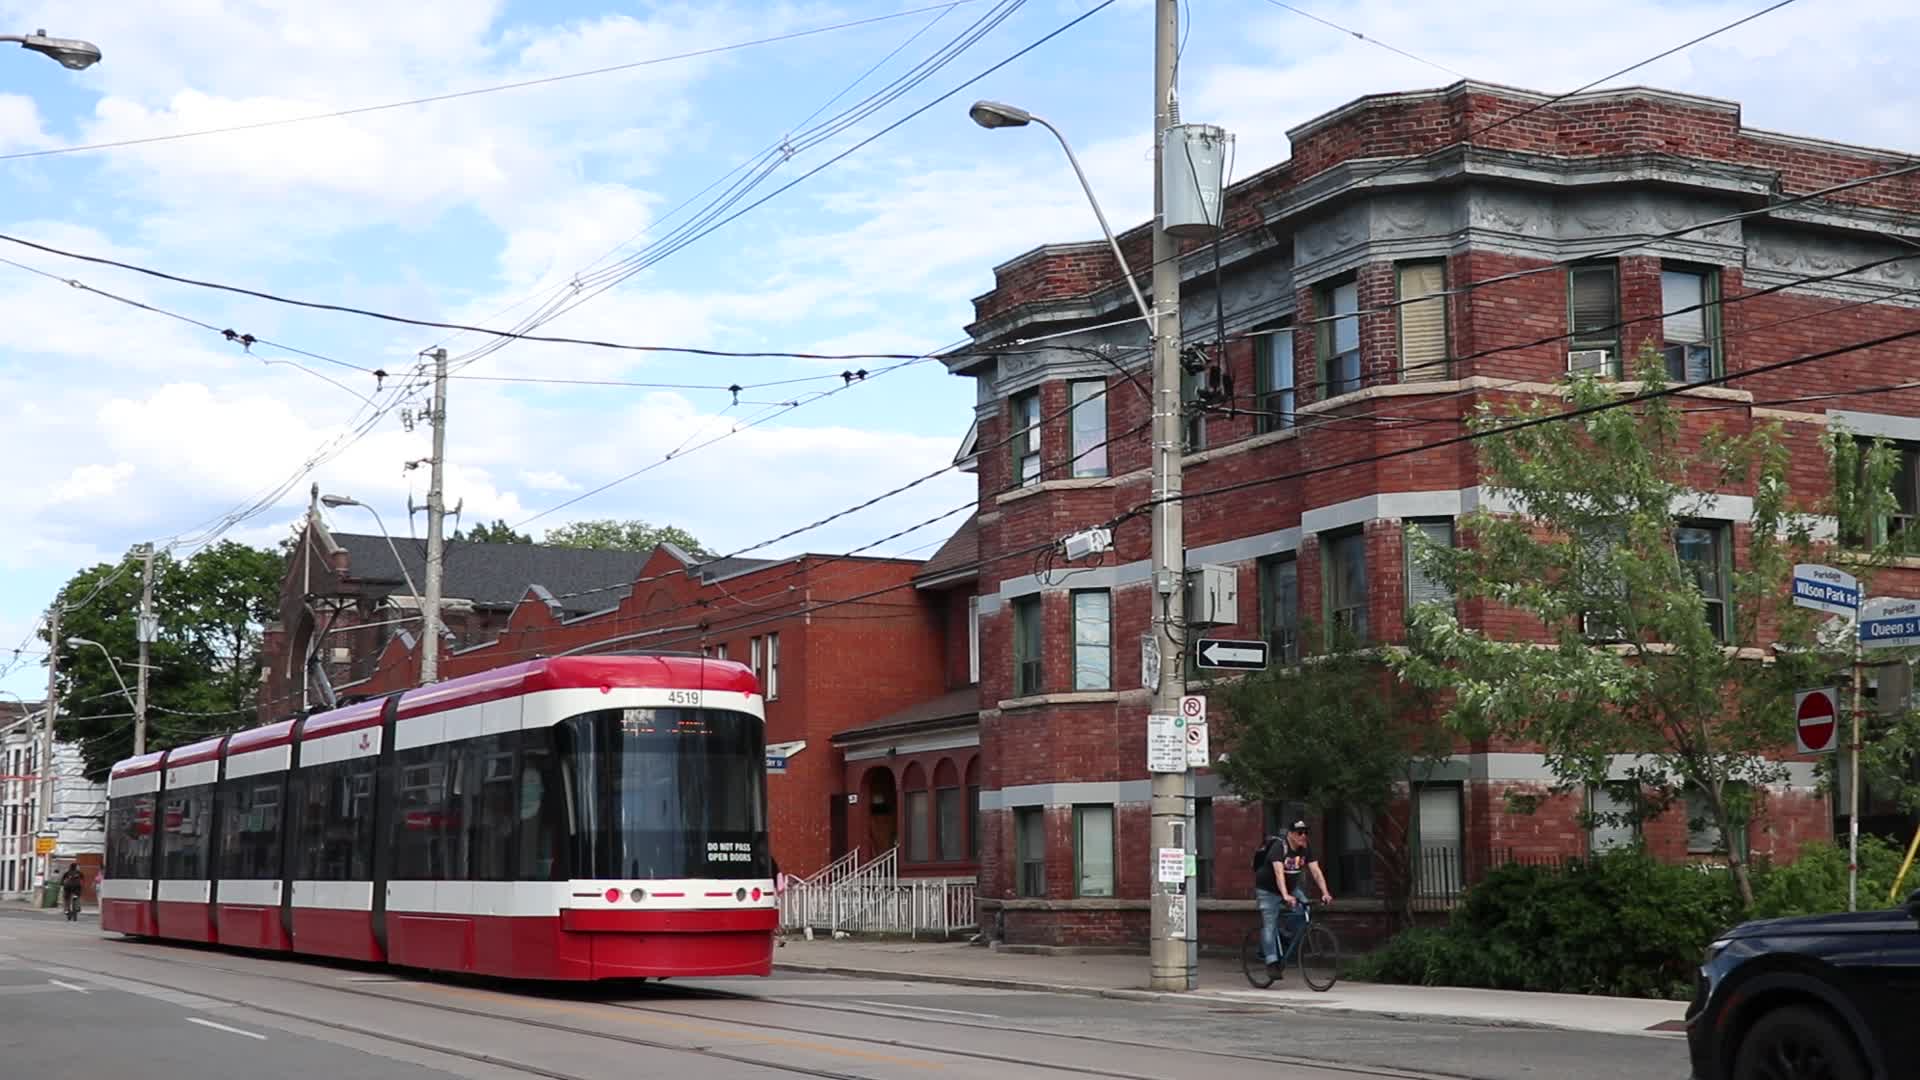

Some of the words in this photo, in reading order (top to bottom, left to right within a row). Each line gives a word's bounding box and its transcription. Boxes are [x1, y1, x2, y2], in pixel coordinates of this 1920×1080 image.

[1797, 581, 1825, 598] Wilson
[1826, 586, 1846, 602] Park
[1847, 594, 1857, 605] Rd
[1871, 622, 1904, 637] Queen
[1905, 623, 1914, 633] St
[668, 691, 699, 704] 4519
[707, 842, 718, 851] DO
[719, 842, 734, 851] NOT
[735, 843, 751, 852] PASS
[708, 852, 728, 861] OPEN
[729, 852, 752, 862] DOORS
